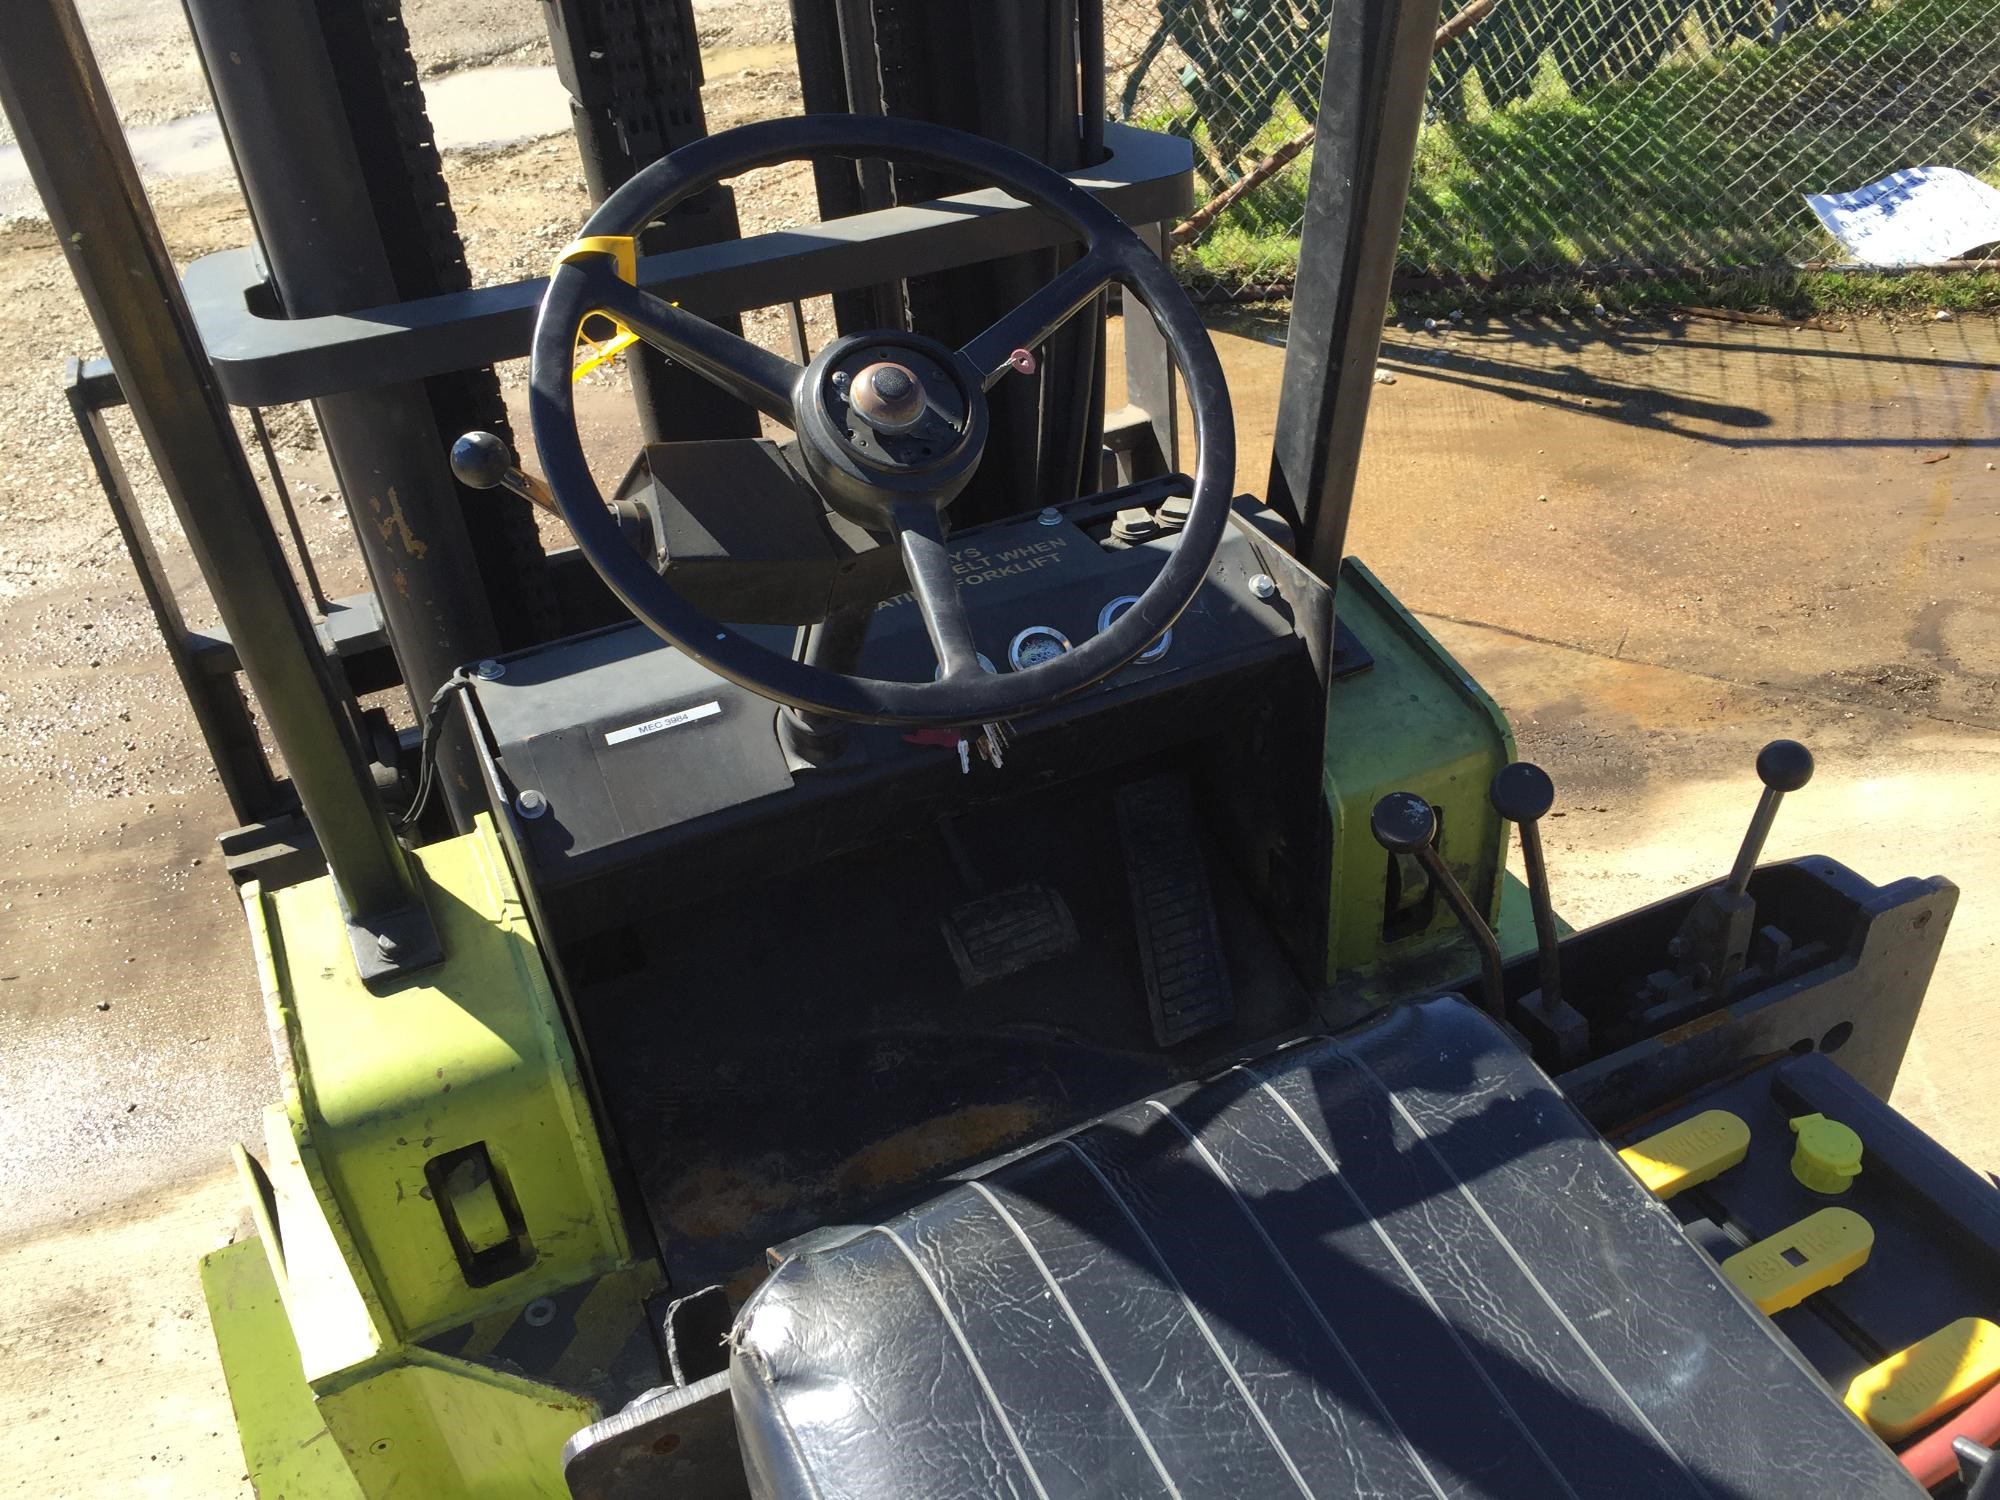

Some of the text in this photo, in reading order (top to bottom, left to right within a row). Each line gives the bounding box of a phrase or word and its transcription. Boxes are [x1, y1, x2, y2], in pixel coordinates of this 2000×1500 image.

[952, 538, 1067, 575] ELT WHEN
[638, 713, 689, 734] MEC 3984
